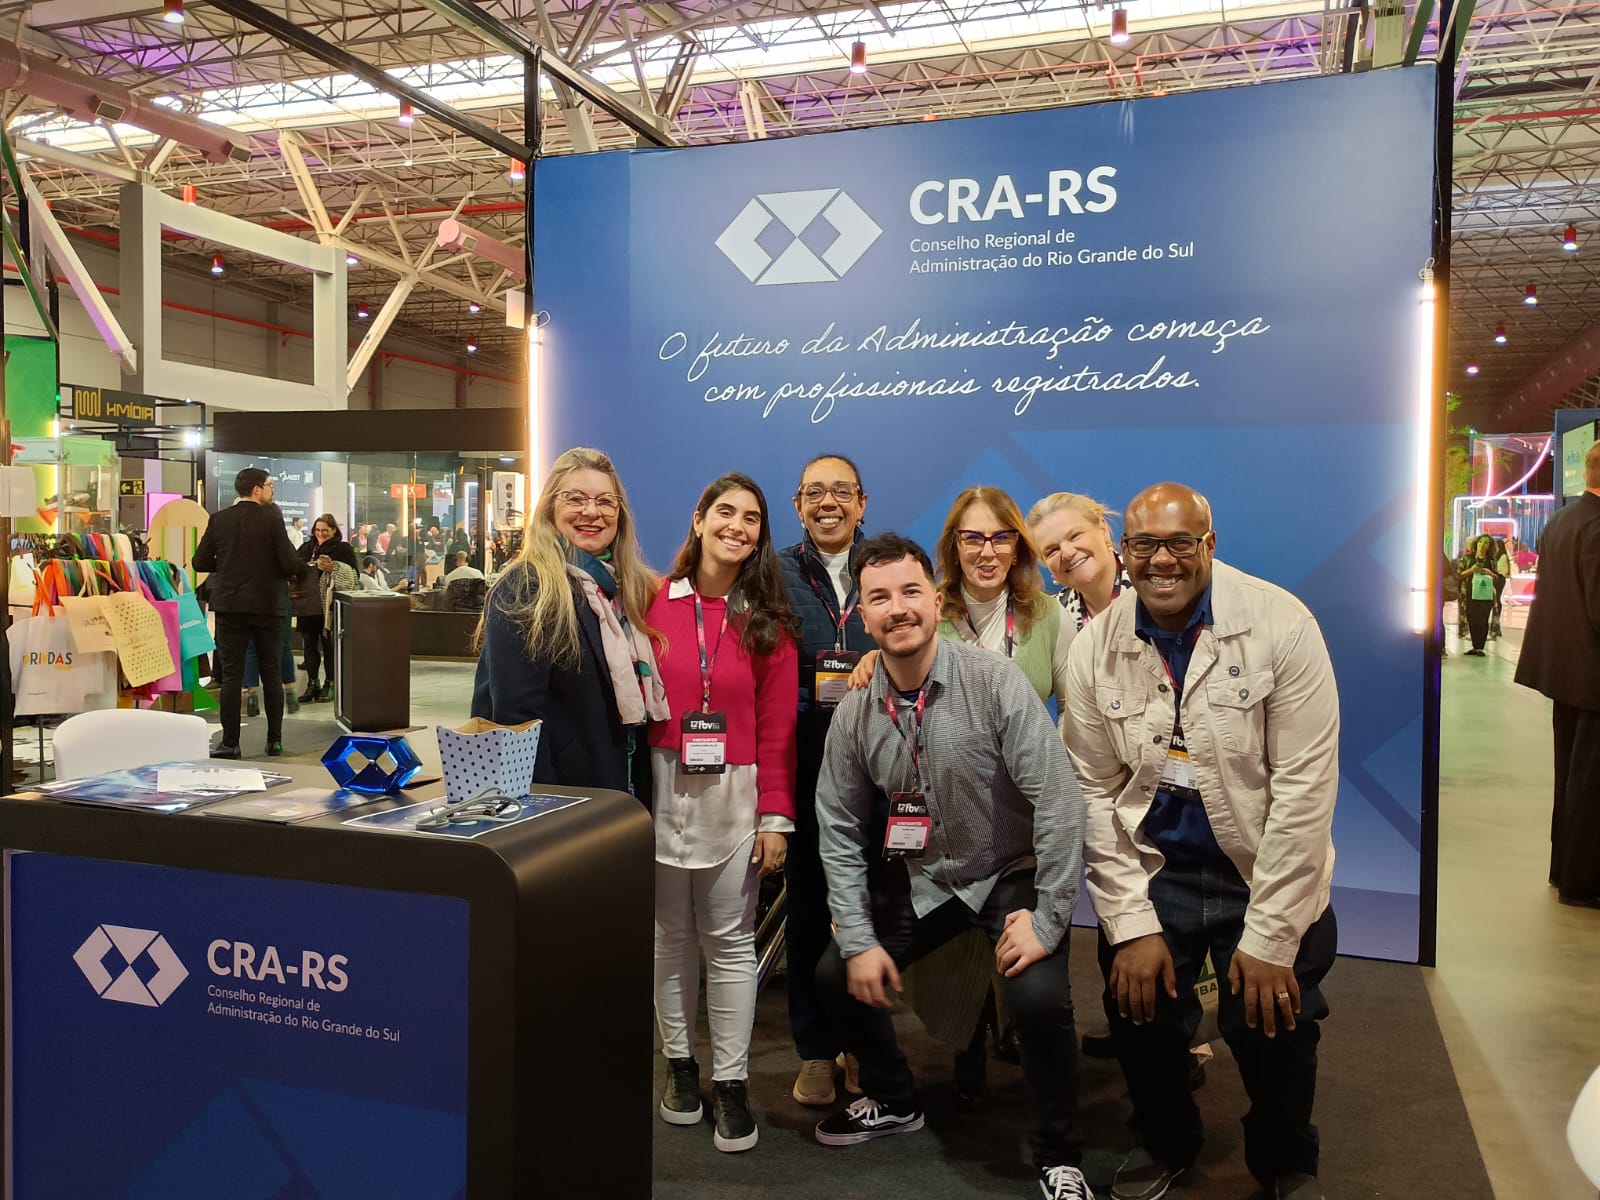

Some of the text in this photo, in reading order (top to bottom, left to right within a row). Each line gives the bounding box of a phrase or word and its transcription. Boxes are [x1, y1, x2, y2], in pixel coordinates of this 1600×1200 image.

[909, 165, 1118, 225] CRA-RS
[909, 241, 1194, 274] Administração do Rio Grande do Sul
[910, 228, 1075, 252] Conselho Regional de
[659, 316, 1271, 382] O futuro da Administração começa
[704, 355, 1200, 424] com profissionais registrados.
[207, 938, 349, 992] CRA-RS
[207, 984, 320, 1012] Conselho Regional de
[207, 1002, 400, 1042] Administração do Rio Grande do Sul
